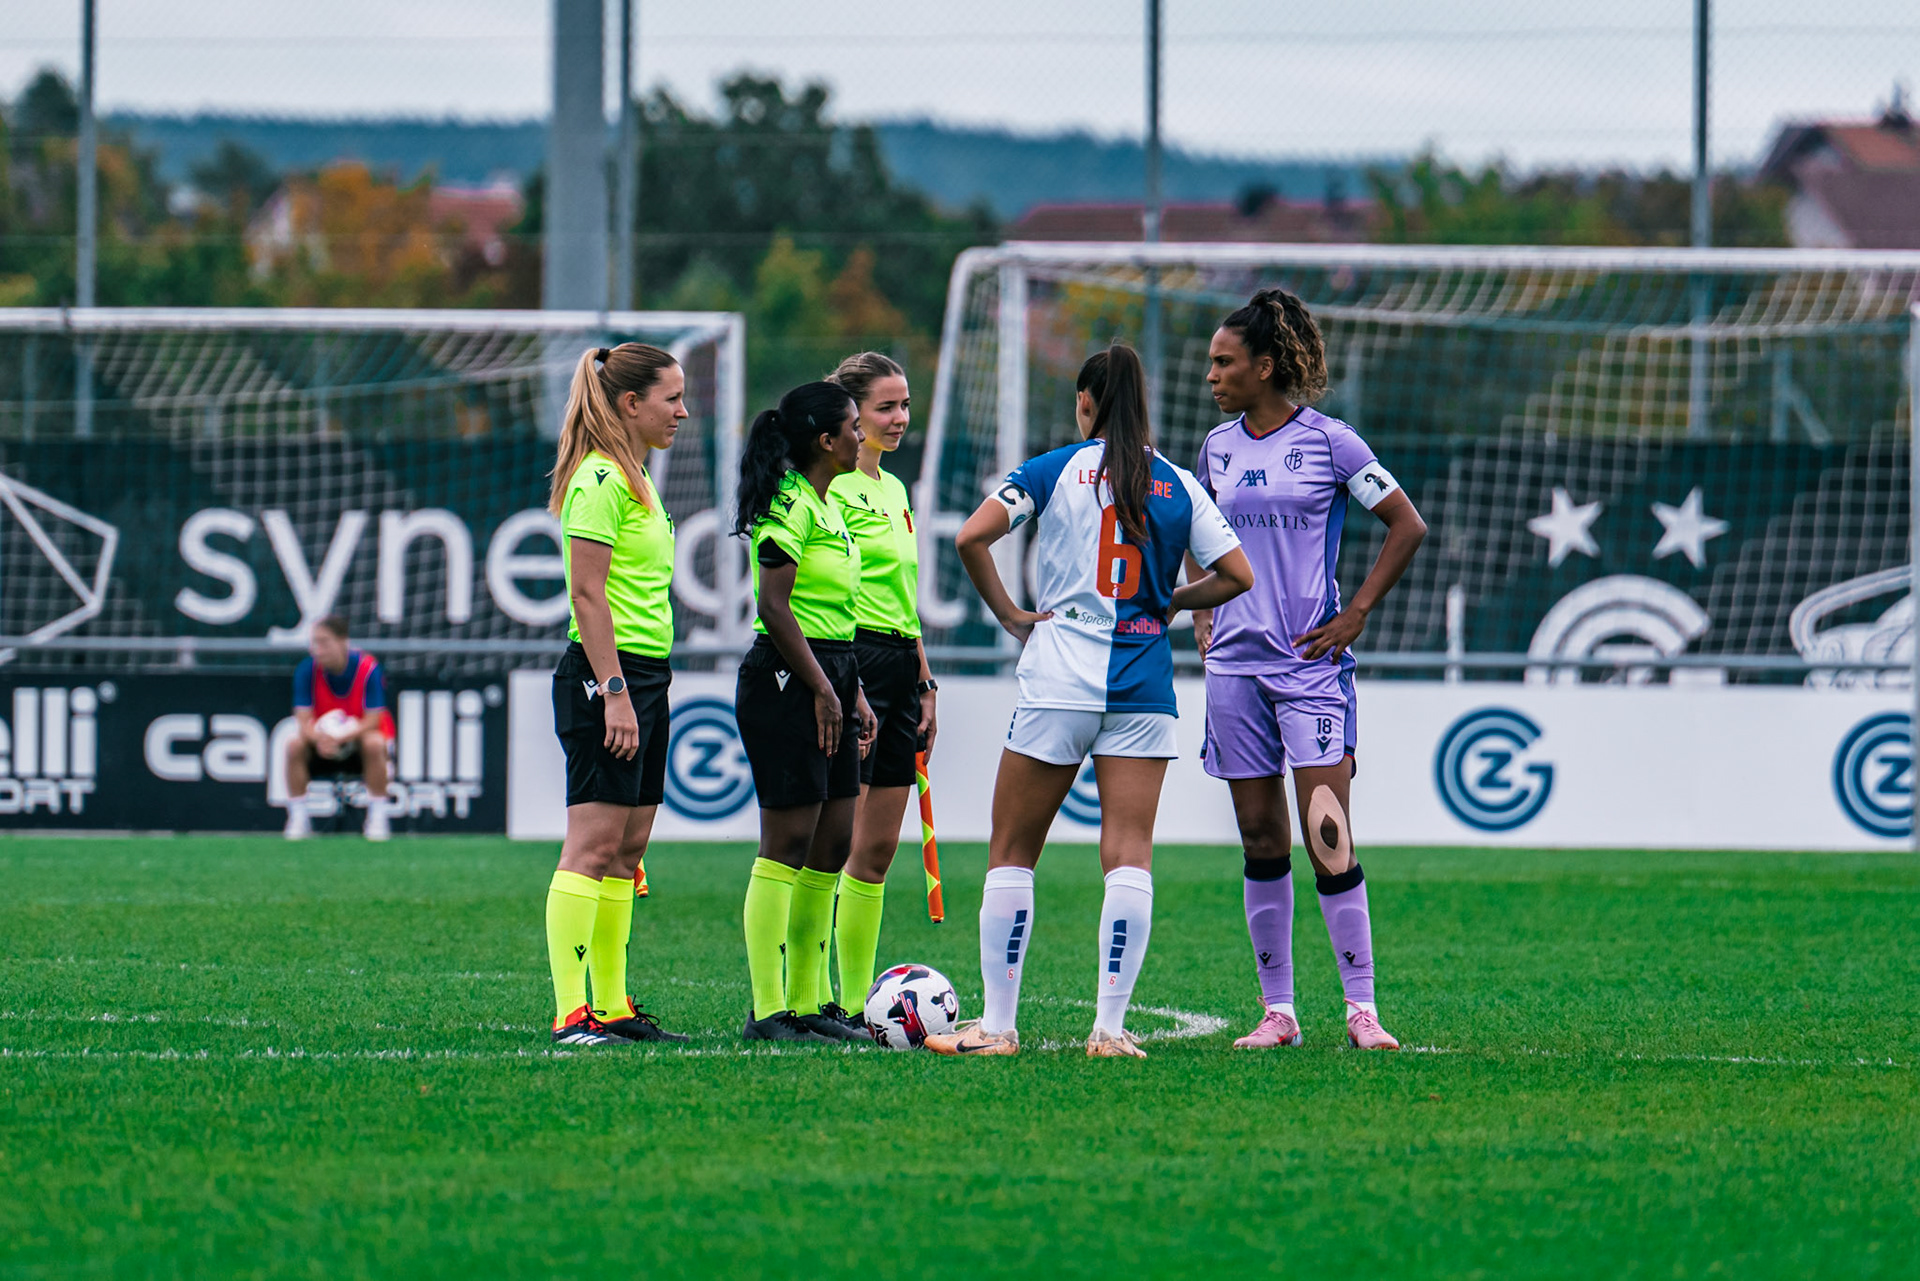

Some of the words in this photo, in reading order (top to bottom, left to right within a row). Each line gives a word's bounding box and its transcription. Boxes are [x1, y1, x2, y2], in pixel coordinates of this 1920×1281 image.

[1235, 469, 1267, 488] AXA
[998, 484, 1025, 506] C
[1225, 513, 1309, 531] NOVARTIS
[1096, 504, 1147, 600] 6
[1080, 611, 1114, 628] Spross
[1316, 717, 1332, 735] 18
